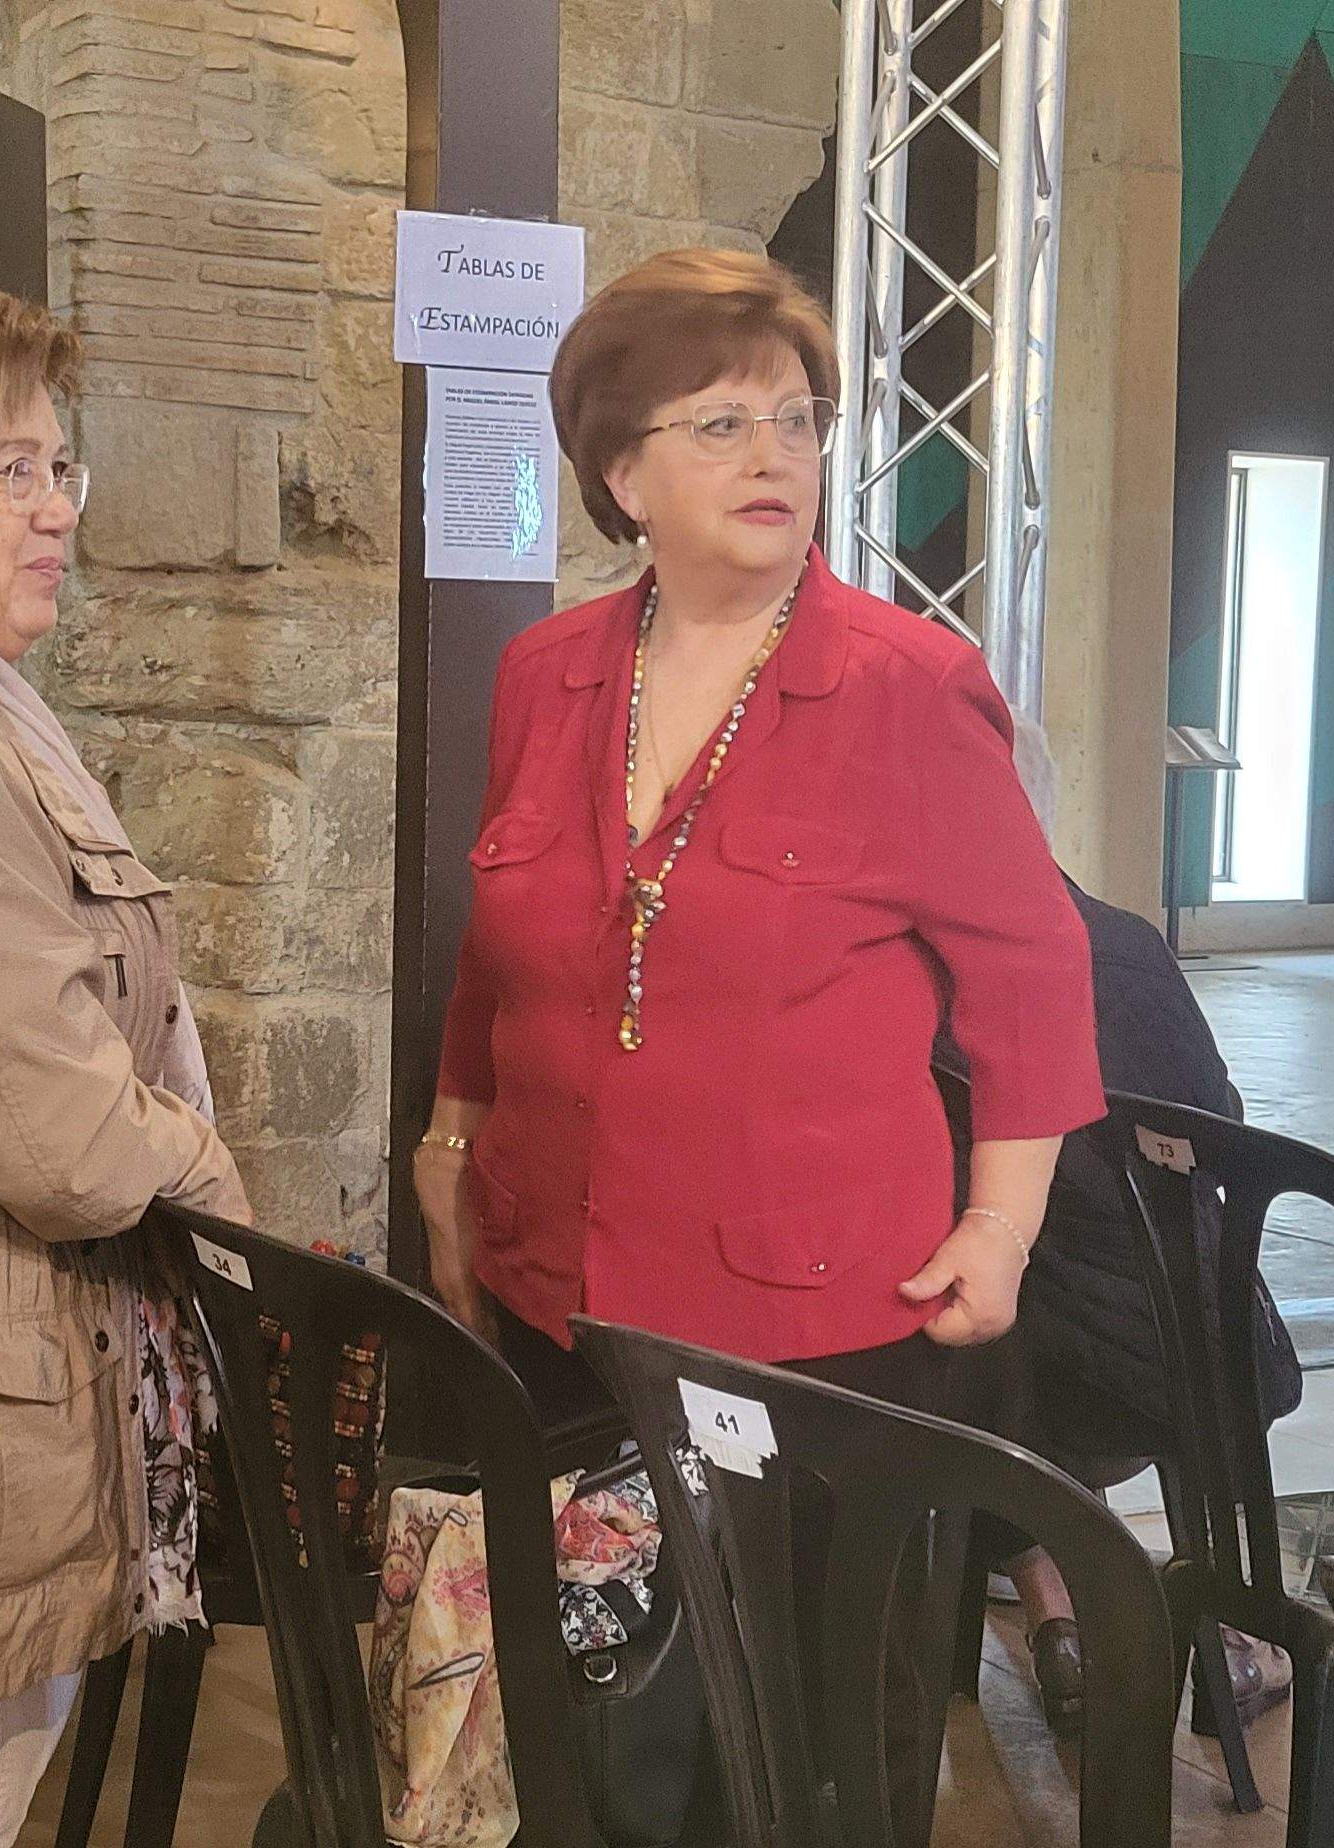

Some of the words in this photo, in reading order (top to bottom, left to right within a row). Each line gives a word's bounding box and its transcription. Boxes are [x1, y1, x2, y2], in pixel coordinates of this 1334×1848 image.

[437, 244, 515, 279] TABLAS
[521, 262, 545, 281] DE
[419, 307, 560, 339] ESTAMPACIÓN
[1156, 1143, 1174, 1158] 73
[212, 1253, 232, 1277] 34
[715, 1411, 740, 1435] 41
